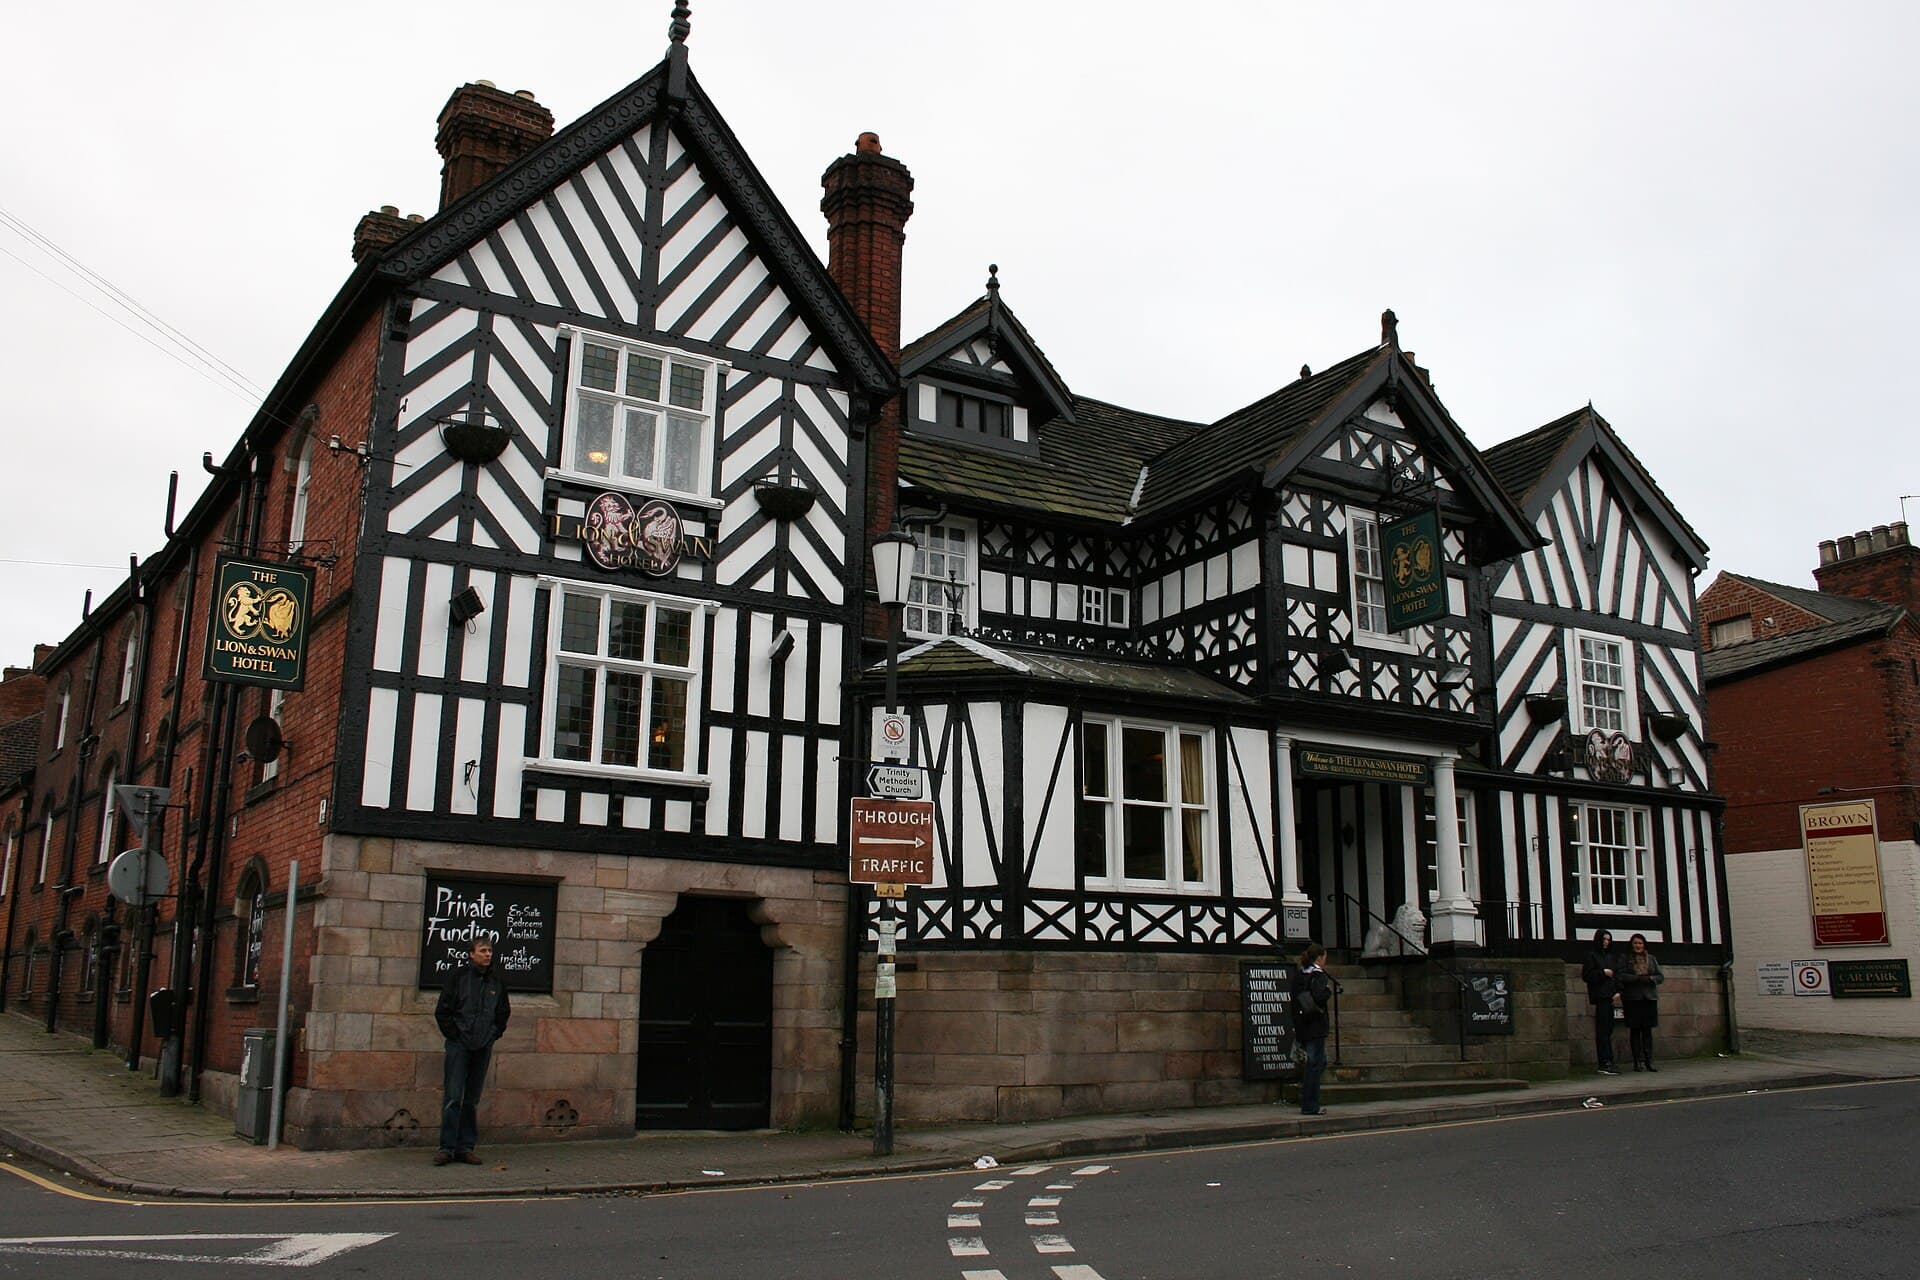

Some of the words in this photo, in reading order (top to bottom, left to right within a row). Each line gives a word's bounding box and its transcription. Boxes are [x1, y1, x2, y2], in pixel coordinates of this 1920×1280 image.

[1401, 524, 1417, 537] THE
[252, 570, 278, 584] THE
[1402, 599, 1429, 614] HOTEL
[232, 656, 277, 673] HOTEL
[1335, 756, 1352, 767] THE
[1397, 763, 1423, 774] HOTEL
[886, 768, 911, 778] Trinity
[879, 776, 917, 786] Methodist
[885, 785, 912, 794] Church
[855, 810, 931, 825] THROUGH
[1807, 812, 1869, 828] BROWN
[861, 858, 924, 873] TRAFFIC
[435, 886, 495, 919] Private
[447, 948, 469, 959] Roo
[1805, 971, 1815, 984] 5
[1866, 971, 1897, 982] PARK
